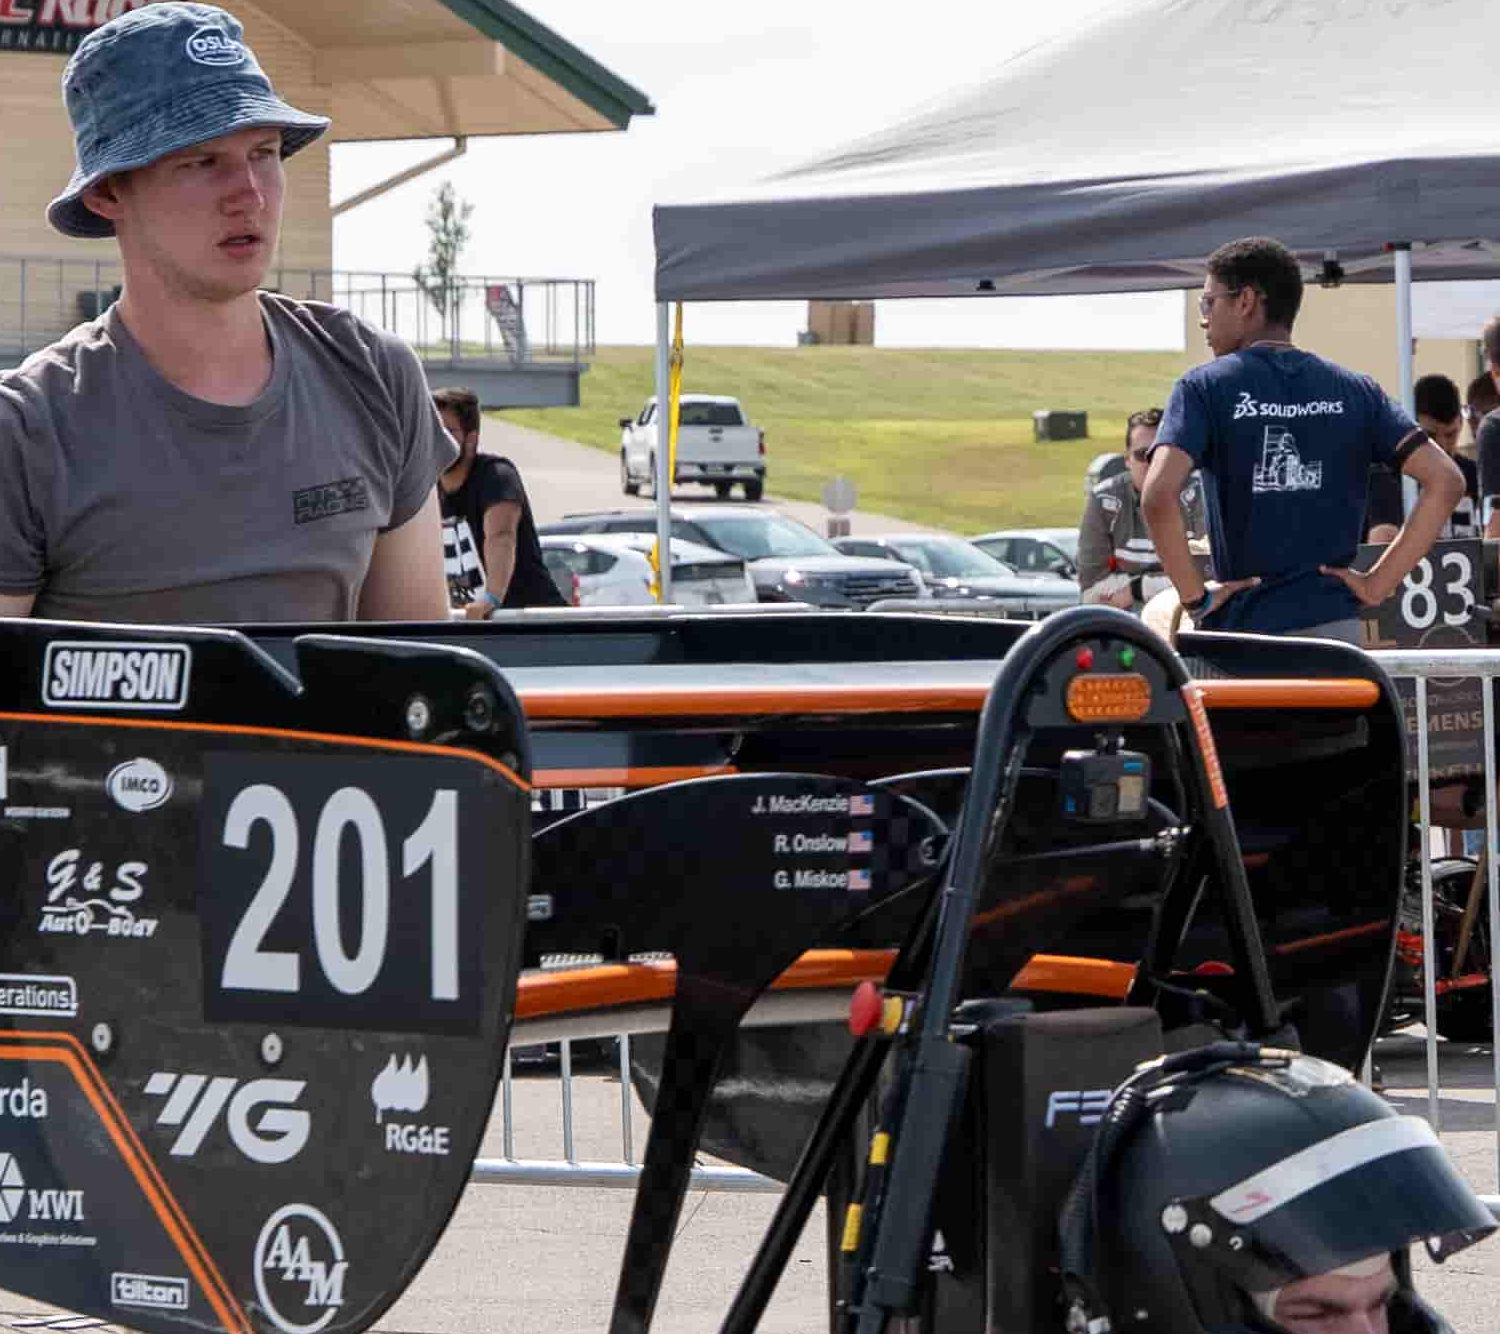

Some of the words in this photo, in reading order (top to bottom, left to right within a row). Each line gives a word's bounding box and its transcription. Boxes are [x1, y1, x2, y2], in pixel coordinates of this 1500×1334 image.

[1260, 400, 1344, 418] SOLIDWORKS
[1402, 551, 1474, 629] 83
[51, 650, 180, 700] SIMPSON
[769, 794, 849, 814] MacKenzie
[773, 834, 790, 853] R.
[792, 834, 849, 852] Onslow
[109, 861, 148, 901] S
[221, 783, 460, 1001] 201
[773, 870, 790, 889] G.
[794, 870, 849, 888] Miskoe
[385, 1122, 452, 1156] RG&E
[28, 1189, 85, 1221] MWI
[264, 1225, 349, 1306] AAM
[116, 1276, 184, 1304] tilton
